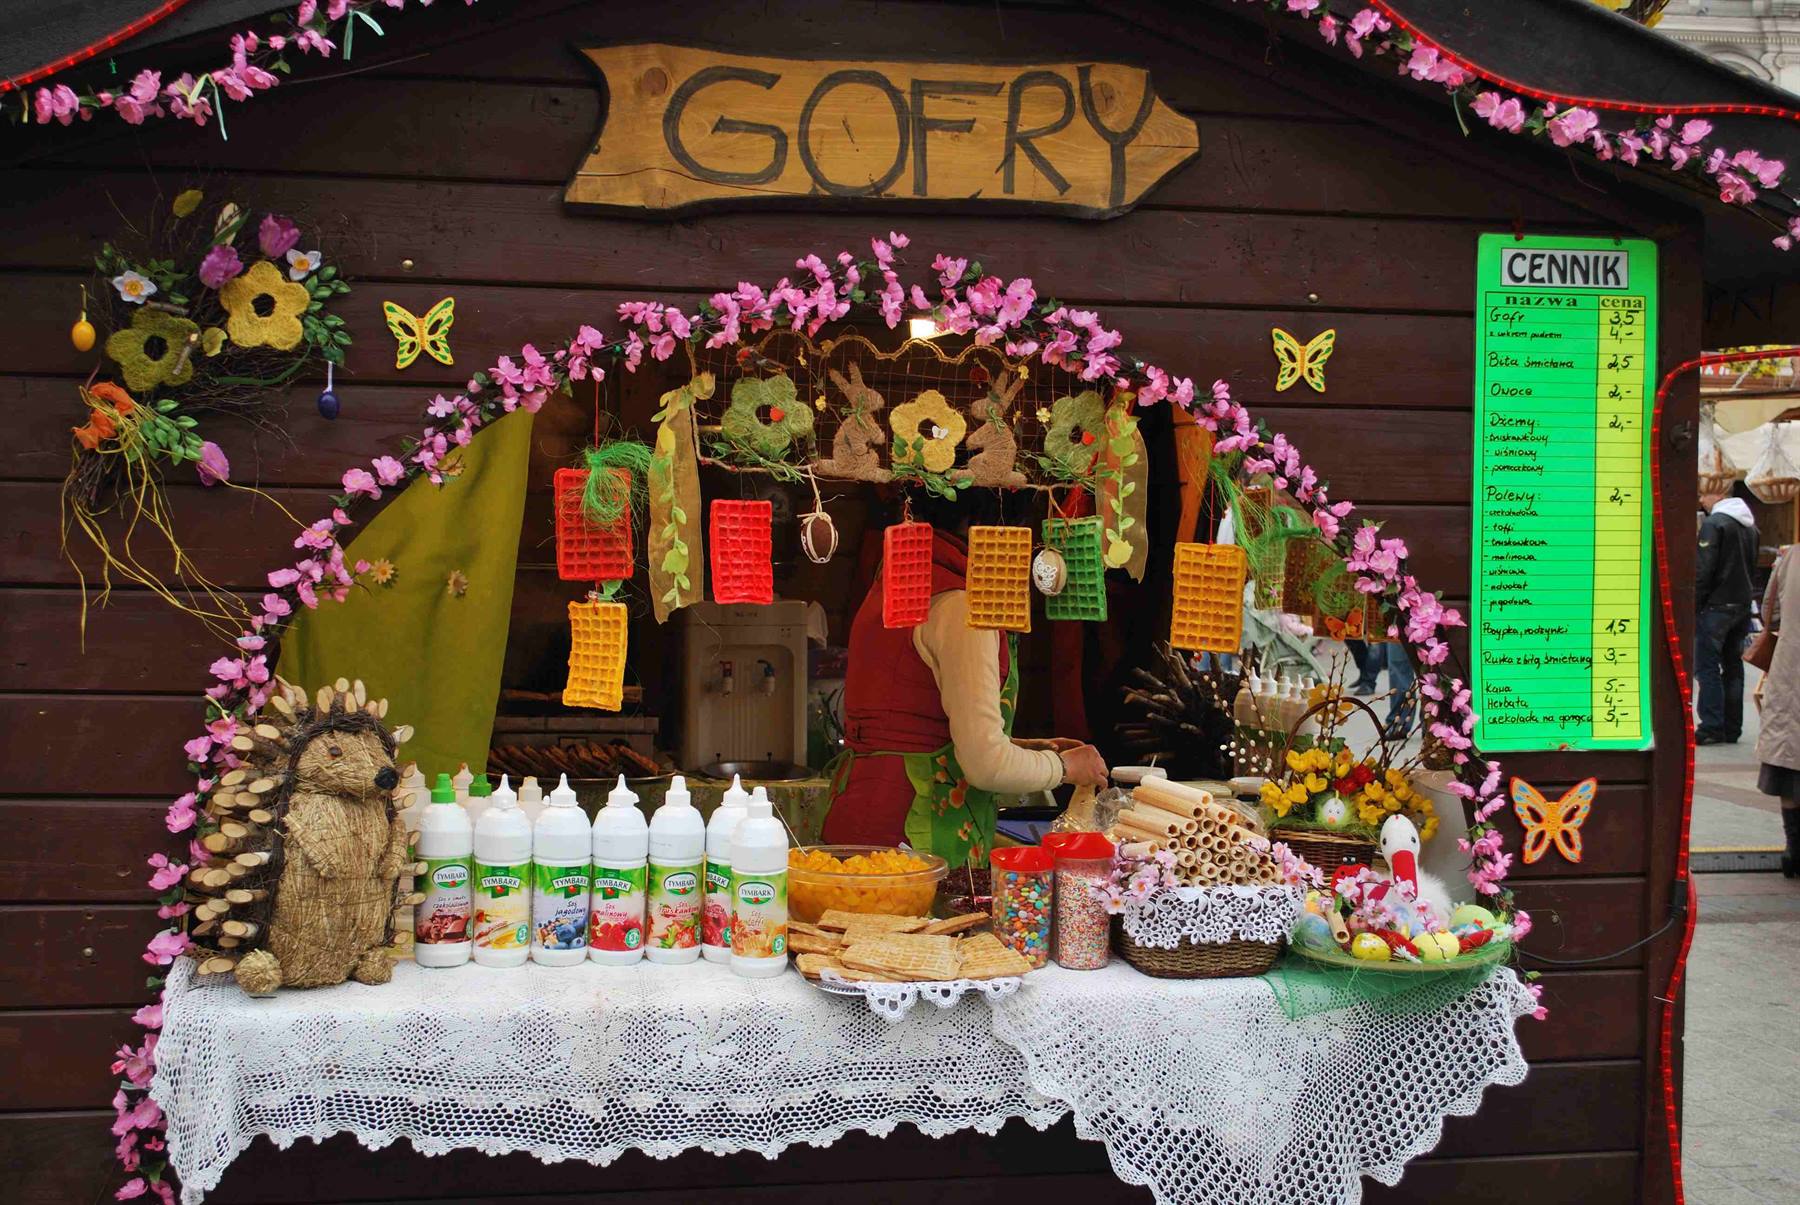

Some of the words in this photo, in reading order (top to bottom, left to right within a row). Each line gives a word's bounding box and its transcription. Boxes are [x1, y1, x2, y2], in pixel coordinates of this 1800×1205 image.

[662, 64, 1155, 208] GOFRY
[1507, 252, 1621, 286] CENNIK
[1505, 296, 1578, 307] nazwa
[1600, 299, 1643, 309] cena
[1490, 306, 1525, 328] Gofr
[1609, 309, 1640, 328] 3,5
[1488, 351, 1519, 368] Bita
[1607, 353, 1633, 372] 2,5
[1490, 382, 1533, 396] Owoce
[1485, 485, 1541, 511] Polewy:
[1605, 618, 1631, 636] 1,5
[1486, 681, 1512, 693] Kawa
[1488, 695, 1528, 709] Herbata
[436, 871, 467, 881] TYMBARK
[483, 877, 518, 887] TYMBARK
[595, 879, 629, 890] TYMBARK
[741, 888, 772, 897] TYMBARK
